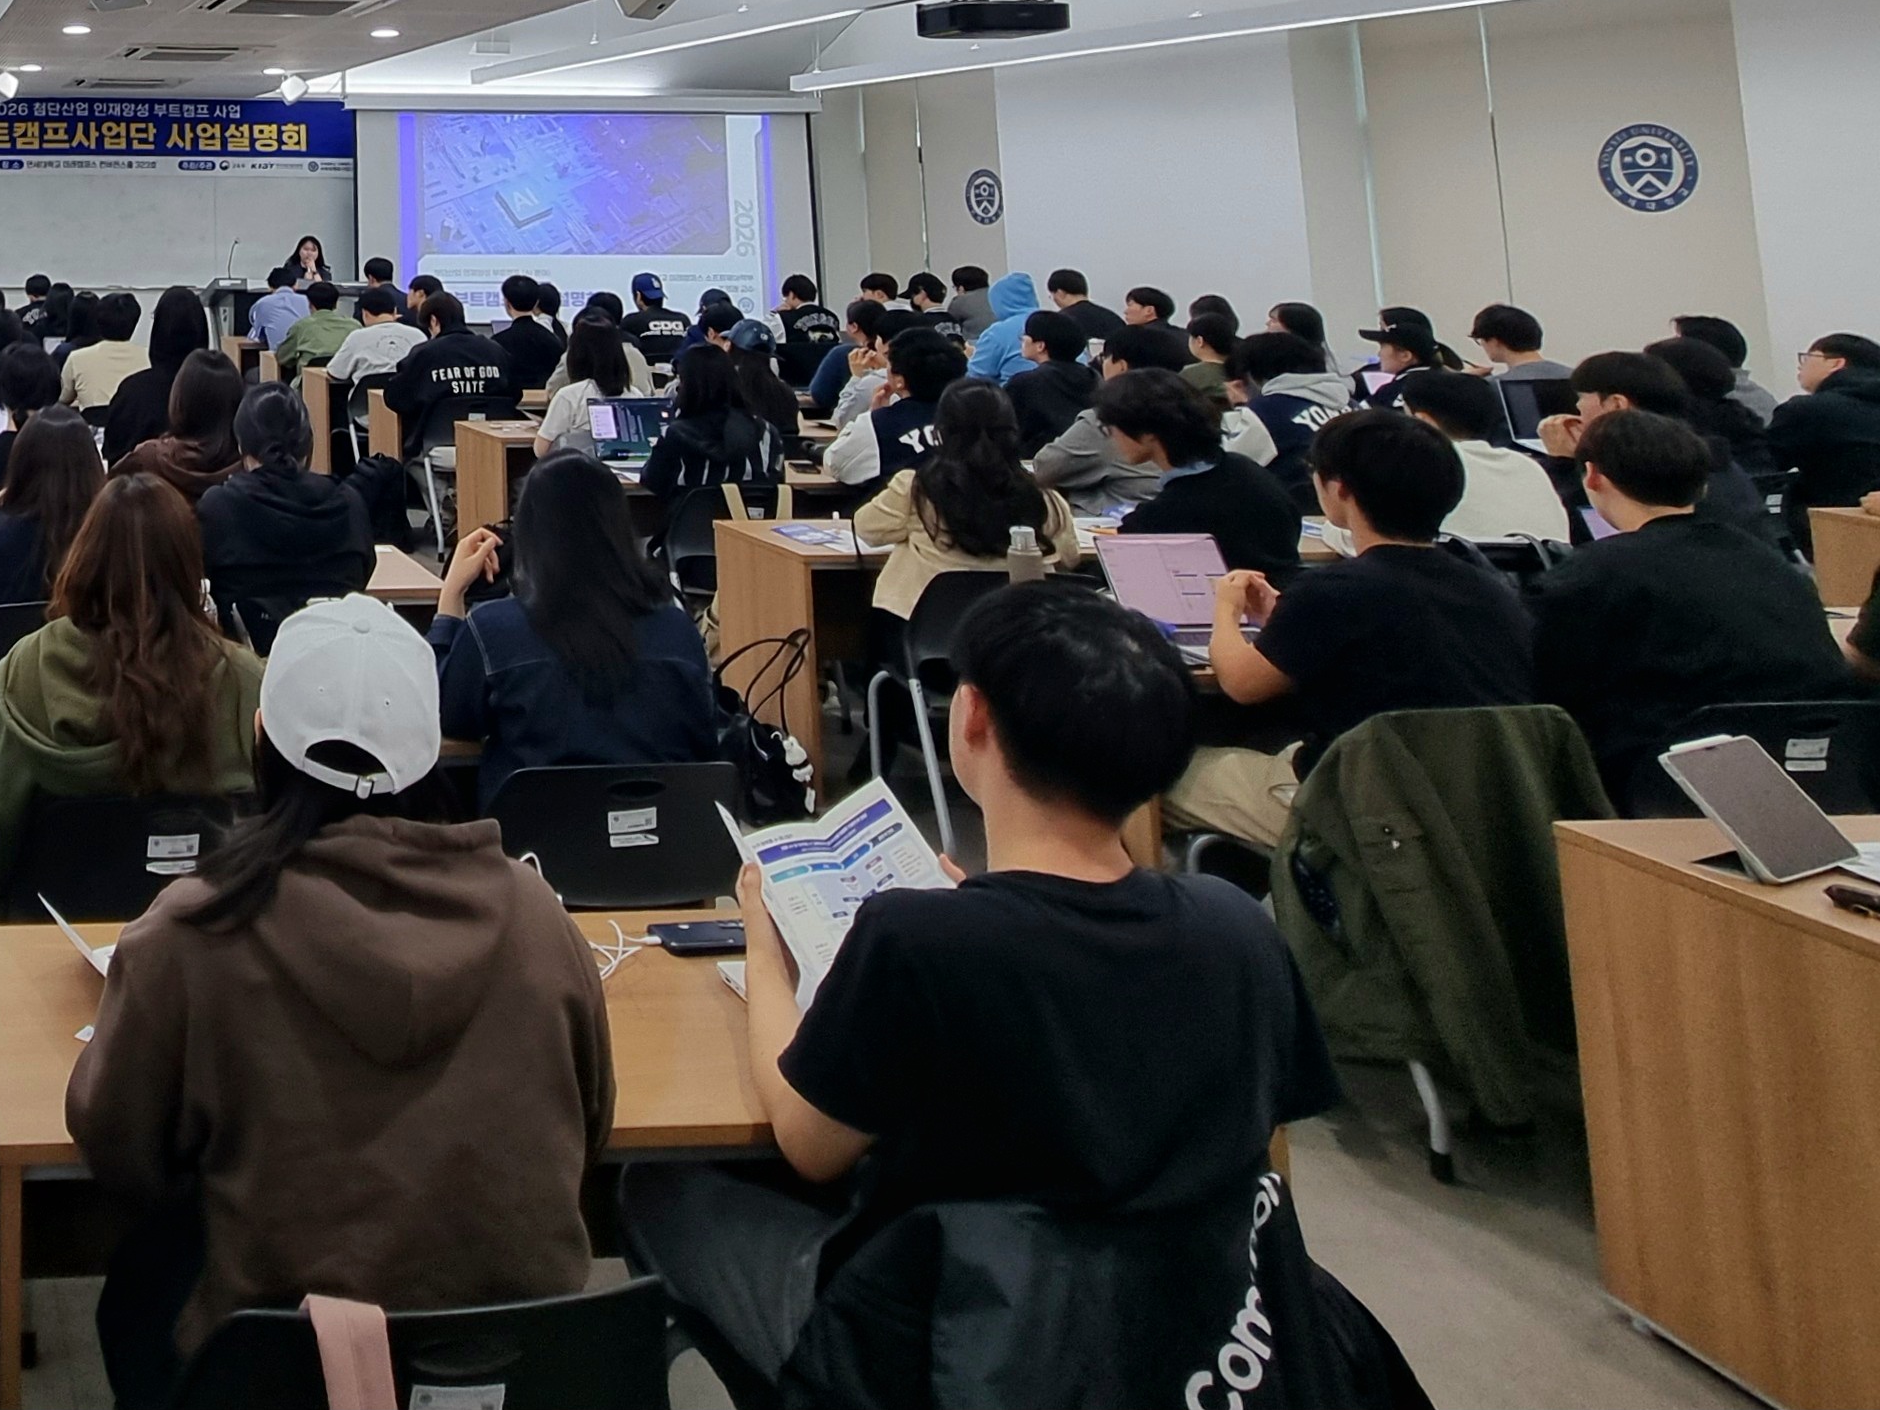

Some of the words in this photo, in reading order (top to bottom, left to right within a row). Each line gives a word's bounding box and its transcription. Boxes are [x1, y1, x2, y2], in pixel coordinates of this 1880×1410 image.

[32, 102, 90, 117] 첨단산업
[93, 102, 150, 118] 인재양성
[152, 103, 211, 118] 부트캠프
[213, 104, 242, 119] 사업
[165, 121, 308, 151] 사업설명회
[733, 198, 755, 258] 2026
[431, 366, 461, 382] FEAR
[463, 366, 476, 379] OF
[478, 366, 500, 378] GOD
[451, 380, 486, 393] STATE
